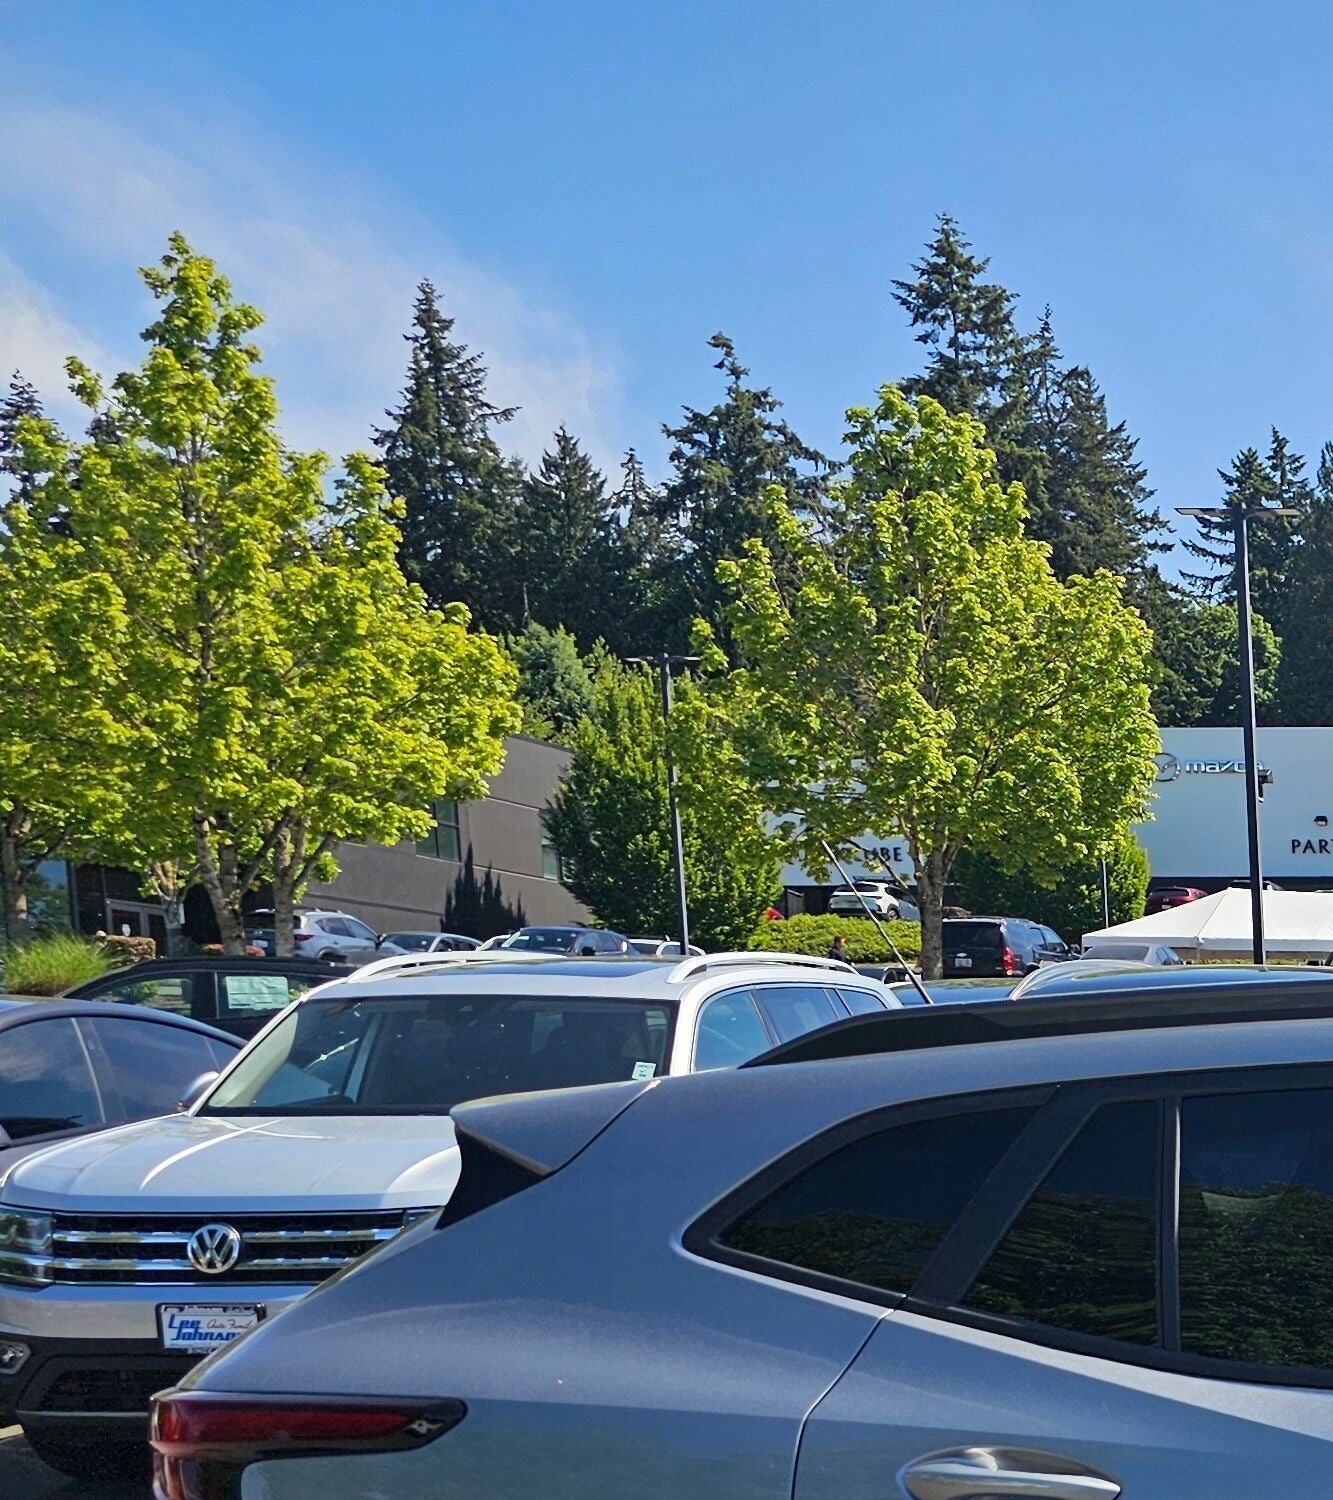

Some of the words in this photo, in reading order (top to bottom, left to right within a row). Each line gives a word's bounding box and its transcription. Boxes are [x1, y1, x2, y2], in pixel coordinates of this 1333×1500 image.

[857, 847, 904, 862] UBE
[168, 1314, 202, 1329] Lee
[228, 1319, 253, 1329] Famil
[170, 1326, 241, 1341] Johnso
